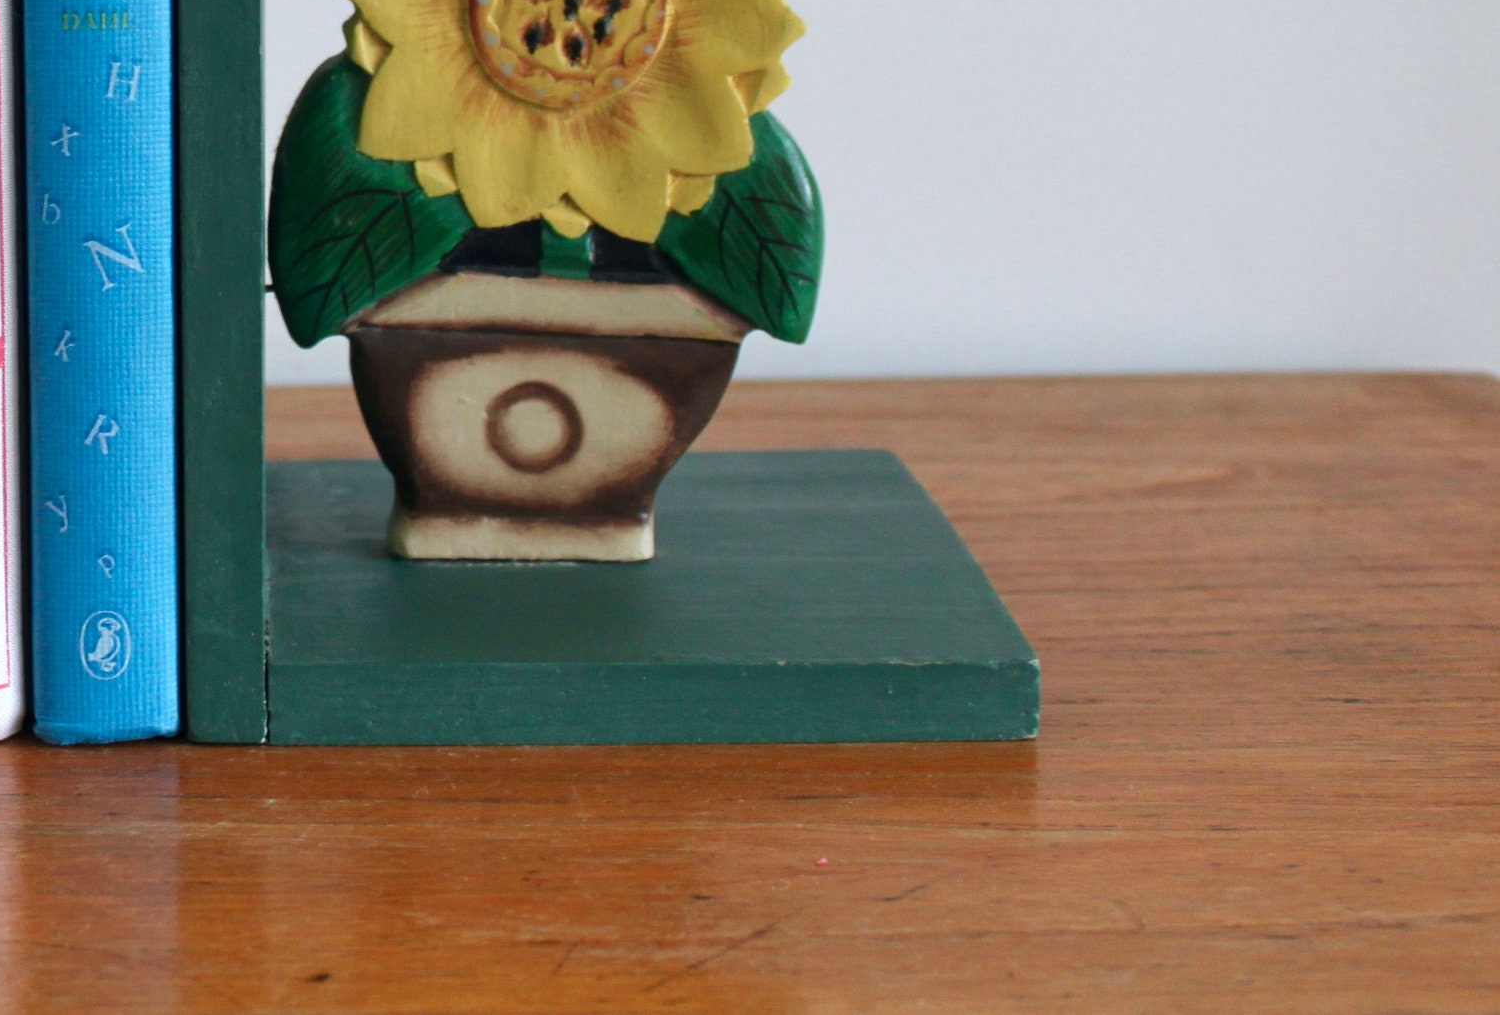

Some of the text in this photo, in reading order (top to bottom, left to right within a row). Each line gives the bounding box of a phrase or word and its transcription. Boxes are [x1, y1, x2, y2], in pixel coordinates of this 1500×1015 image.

[61, 12, 136, 31] DAHL
[106, 61, 142, 102] H
[41, 193, 61, 225] b
[83, 222, 147, 292] N
